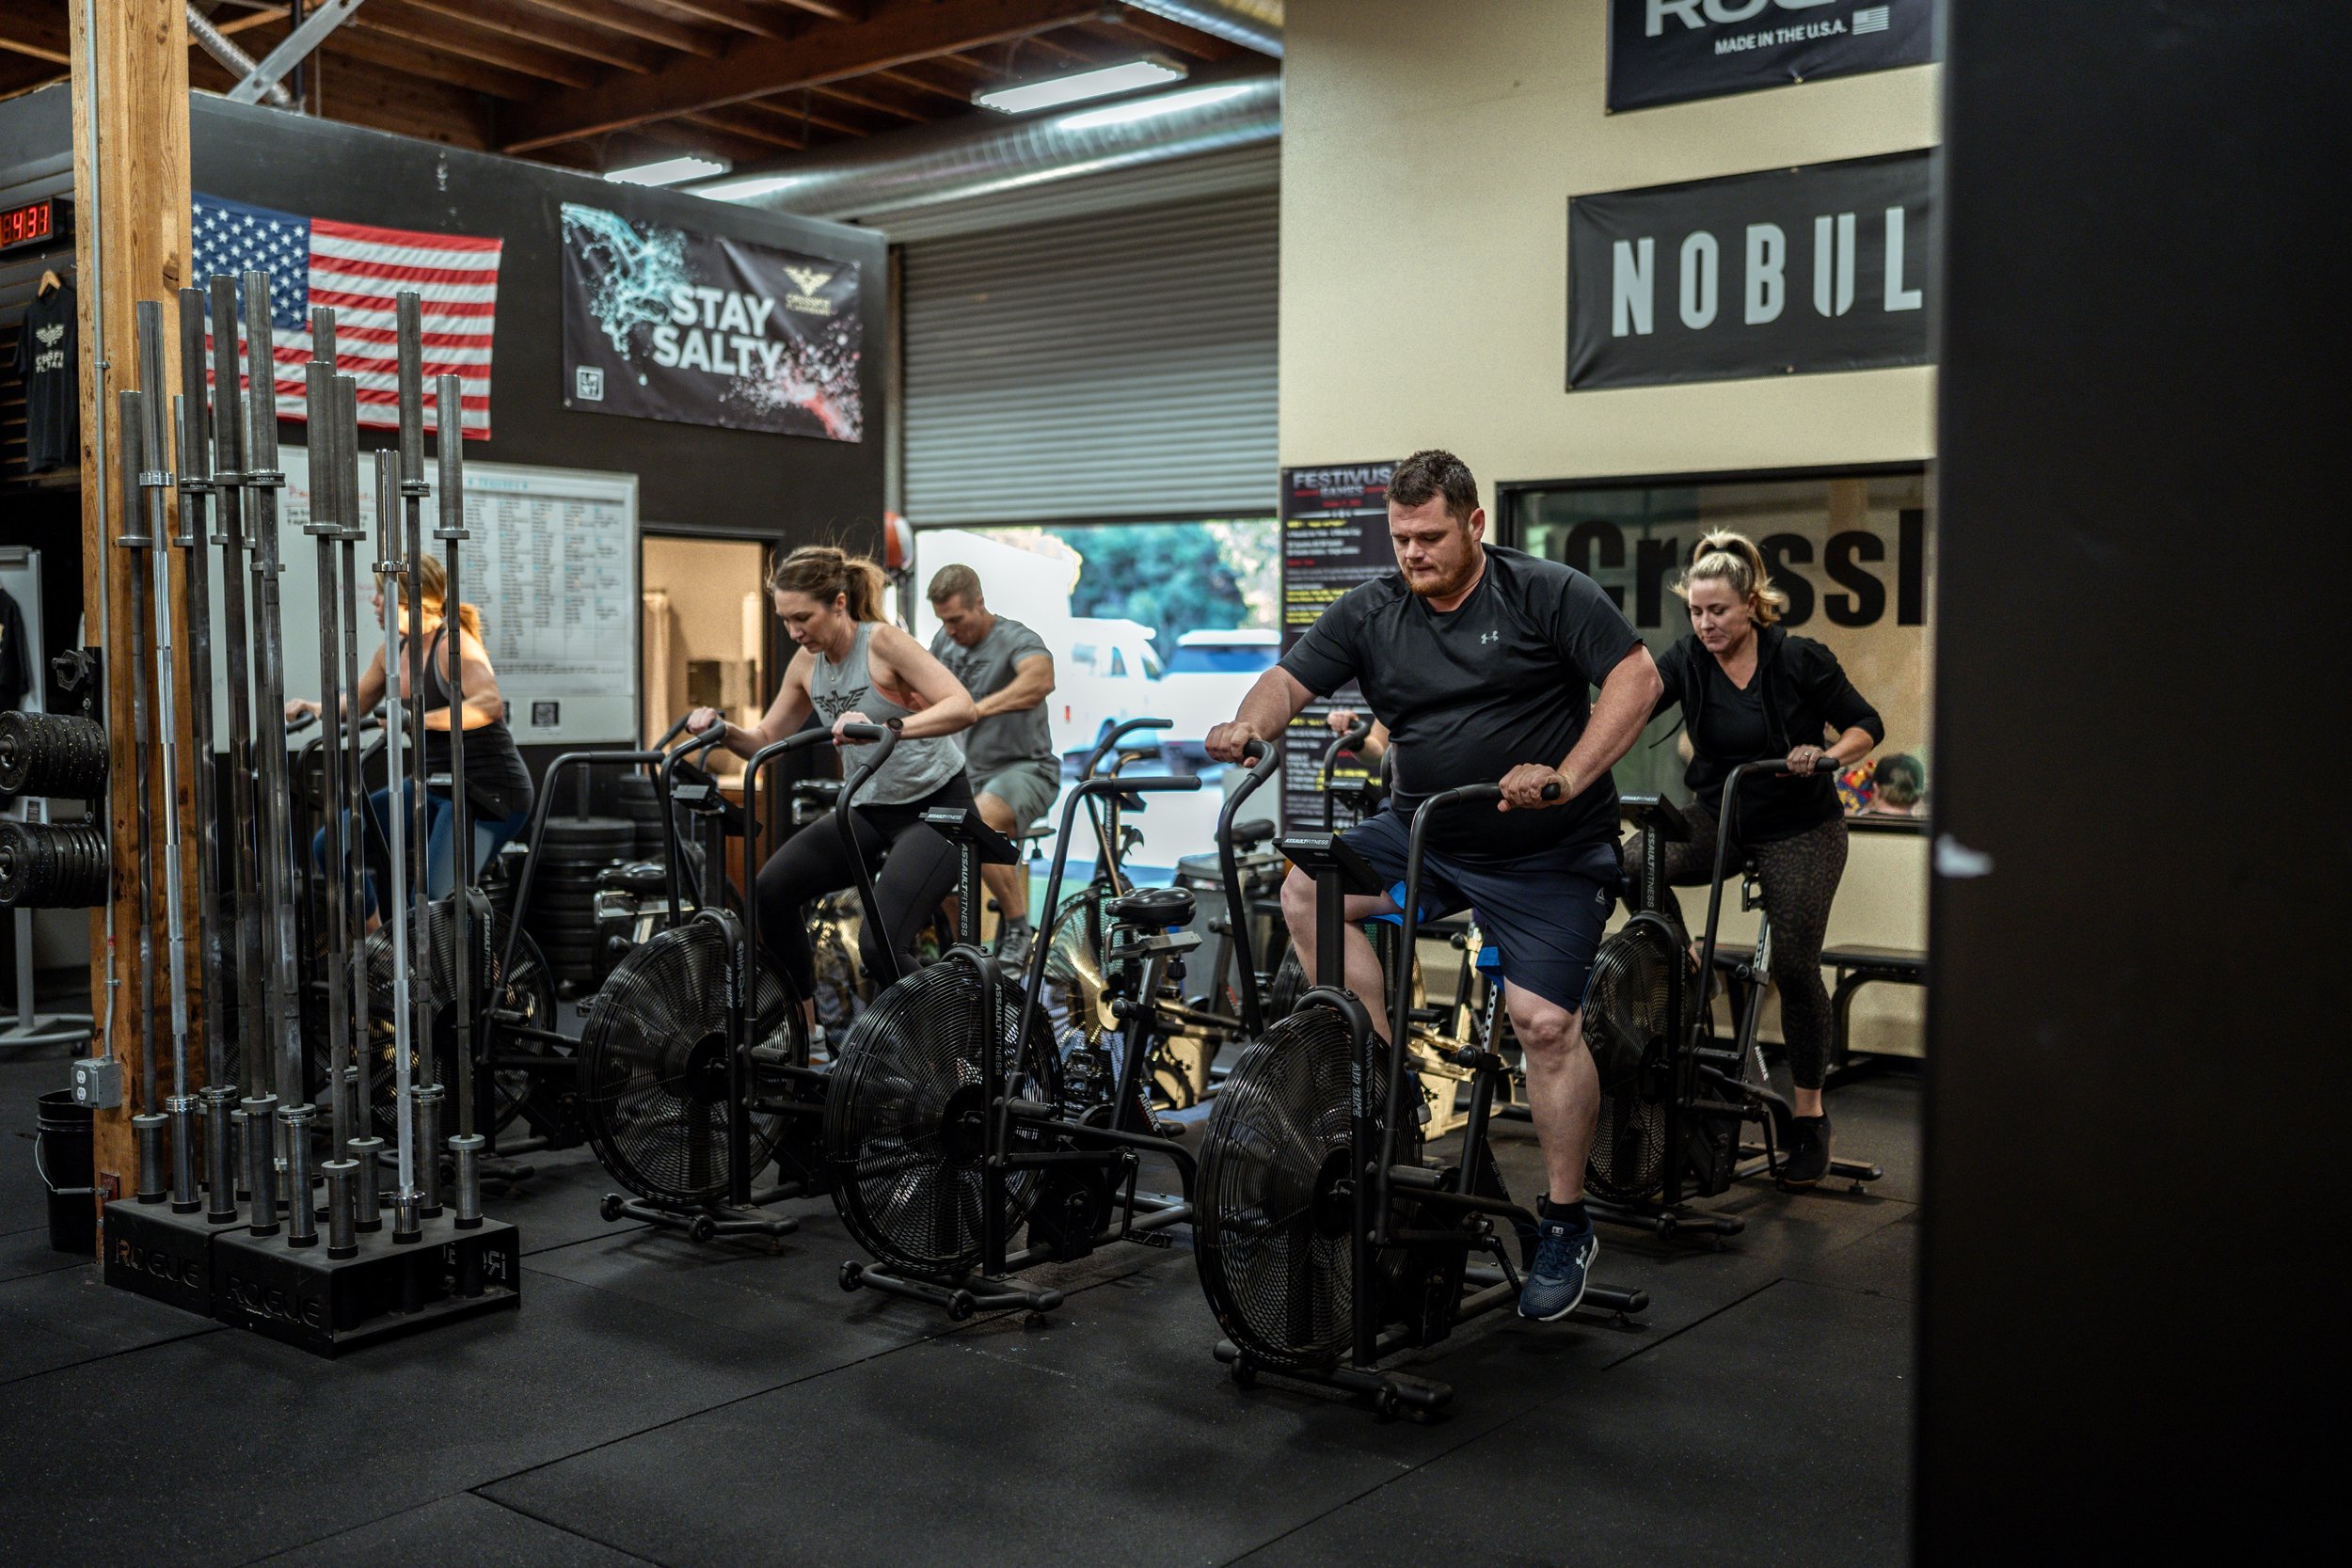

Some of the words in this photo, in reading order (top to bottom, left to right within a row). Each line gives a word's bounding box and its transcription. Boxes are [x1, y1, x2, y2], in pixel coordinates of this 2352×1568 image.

[1714, 34, 1756, 55] MADE
[1757, 31, 1774, 48] IN
[1774, 25, 1805, 45] THE
[1806, 19, 1848, 39] U.S.A.
[1612, 206, 1923, 337] NOBUL
[670, 283, 775, 337] STAY
[652, 324, 787, 380] SALTY
[1293, 466, 1392, 489] FESTIVUS
[958, 843, 968, 937] ASSAULTFITNESS
[1646, 825, 1656, 909] ASSAULTFITNESS
[993, 982, 1004, 1077] ASSAULTFITNESS
[1137, 1093, 1161, 1132] AIRBIKE
[1352, 1087, 1363, 1118] BIKE
[113, 1235, 199, 1289] ROGUE
[227, 1271, 323, 1329] ROGUE
